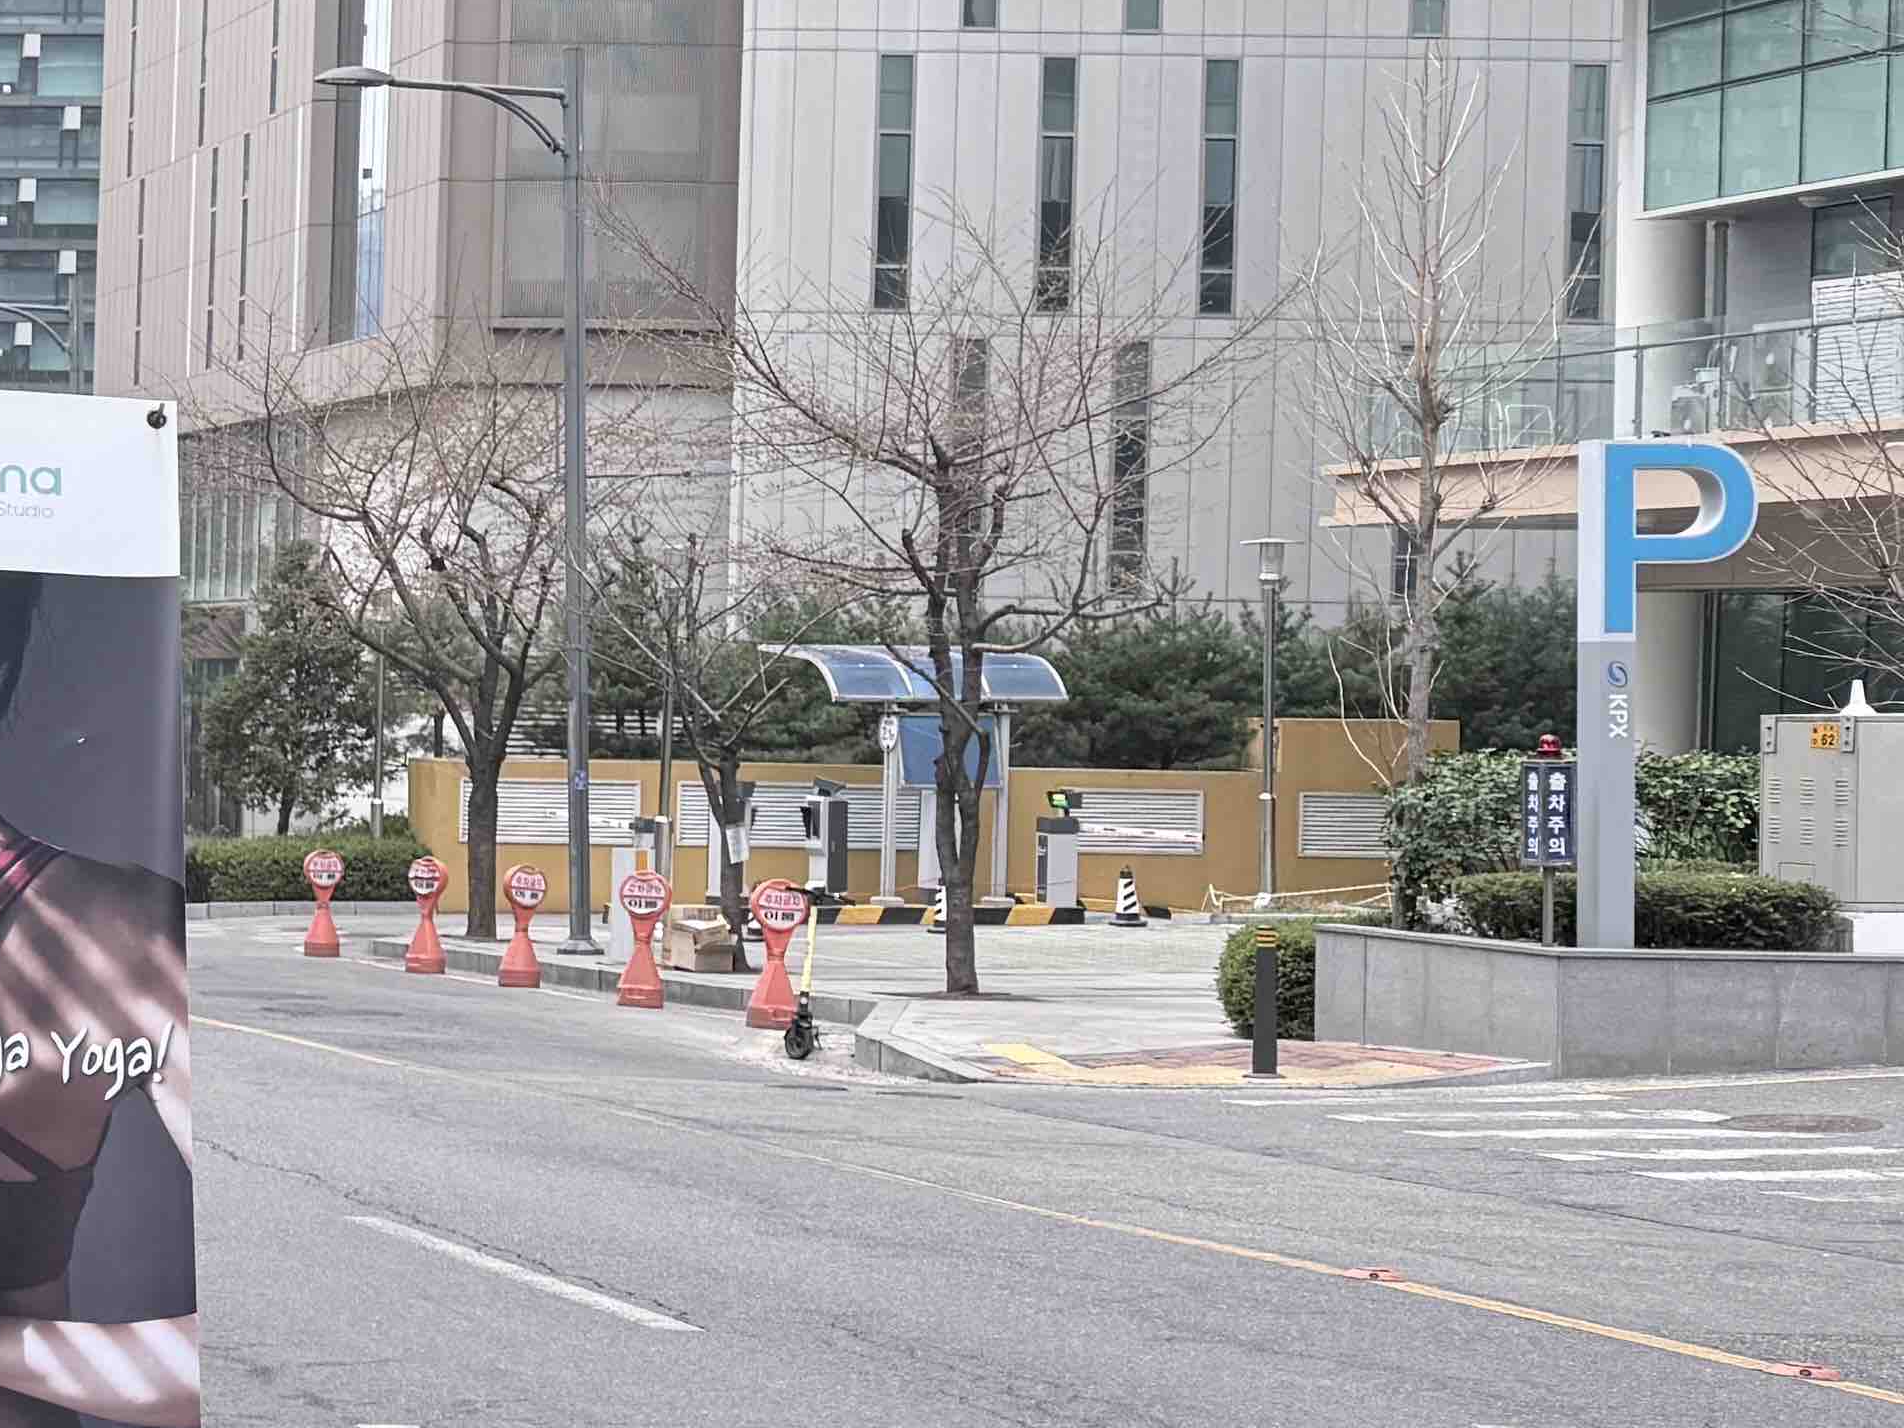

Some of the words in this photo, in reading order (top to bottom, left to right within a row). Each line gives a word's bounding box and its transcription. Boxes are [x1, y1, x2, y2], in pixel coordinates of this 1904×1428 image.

[1603, 441, 1759, 635] P
[1608, 693, 1629, 739] KPX
[1547, 771, 1567, 857] 출차주의
[50, 1020, 175, 1101] Yoga!
